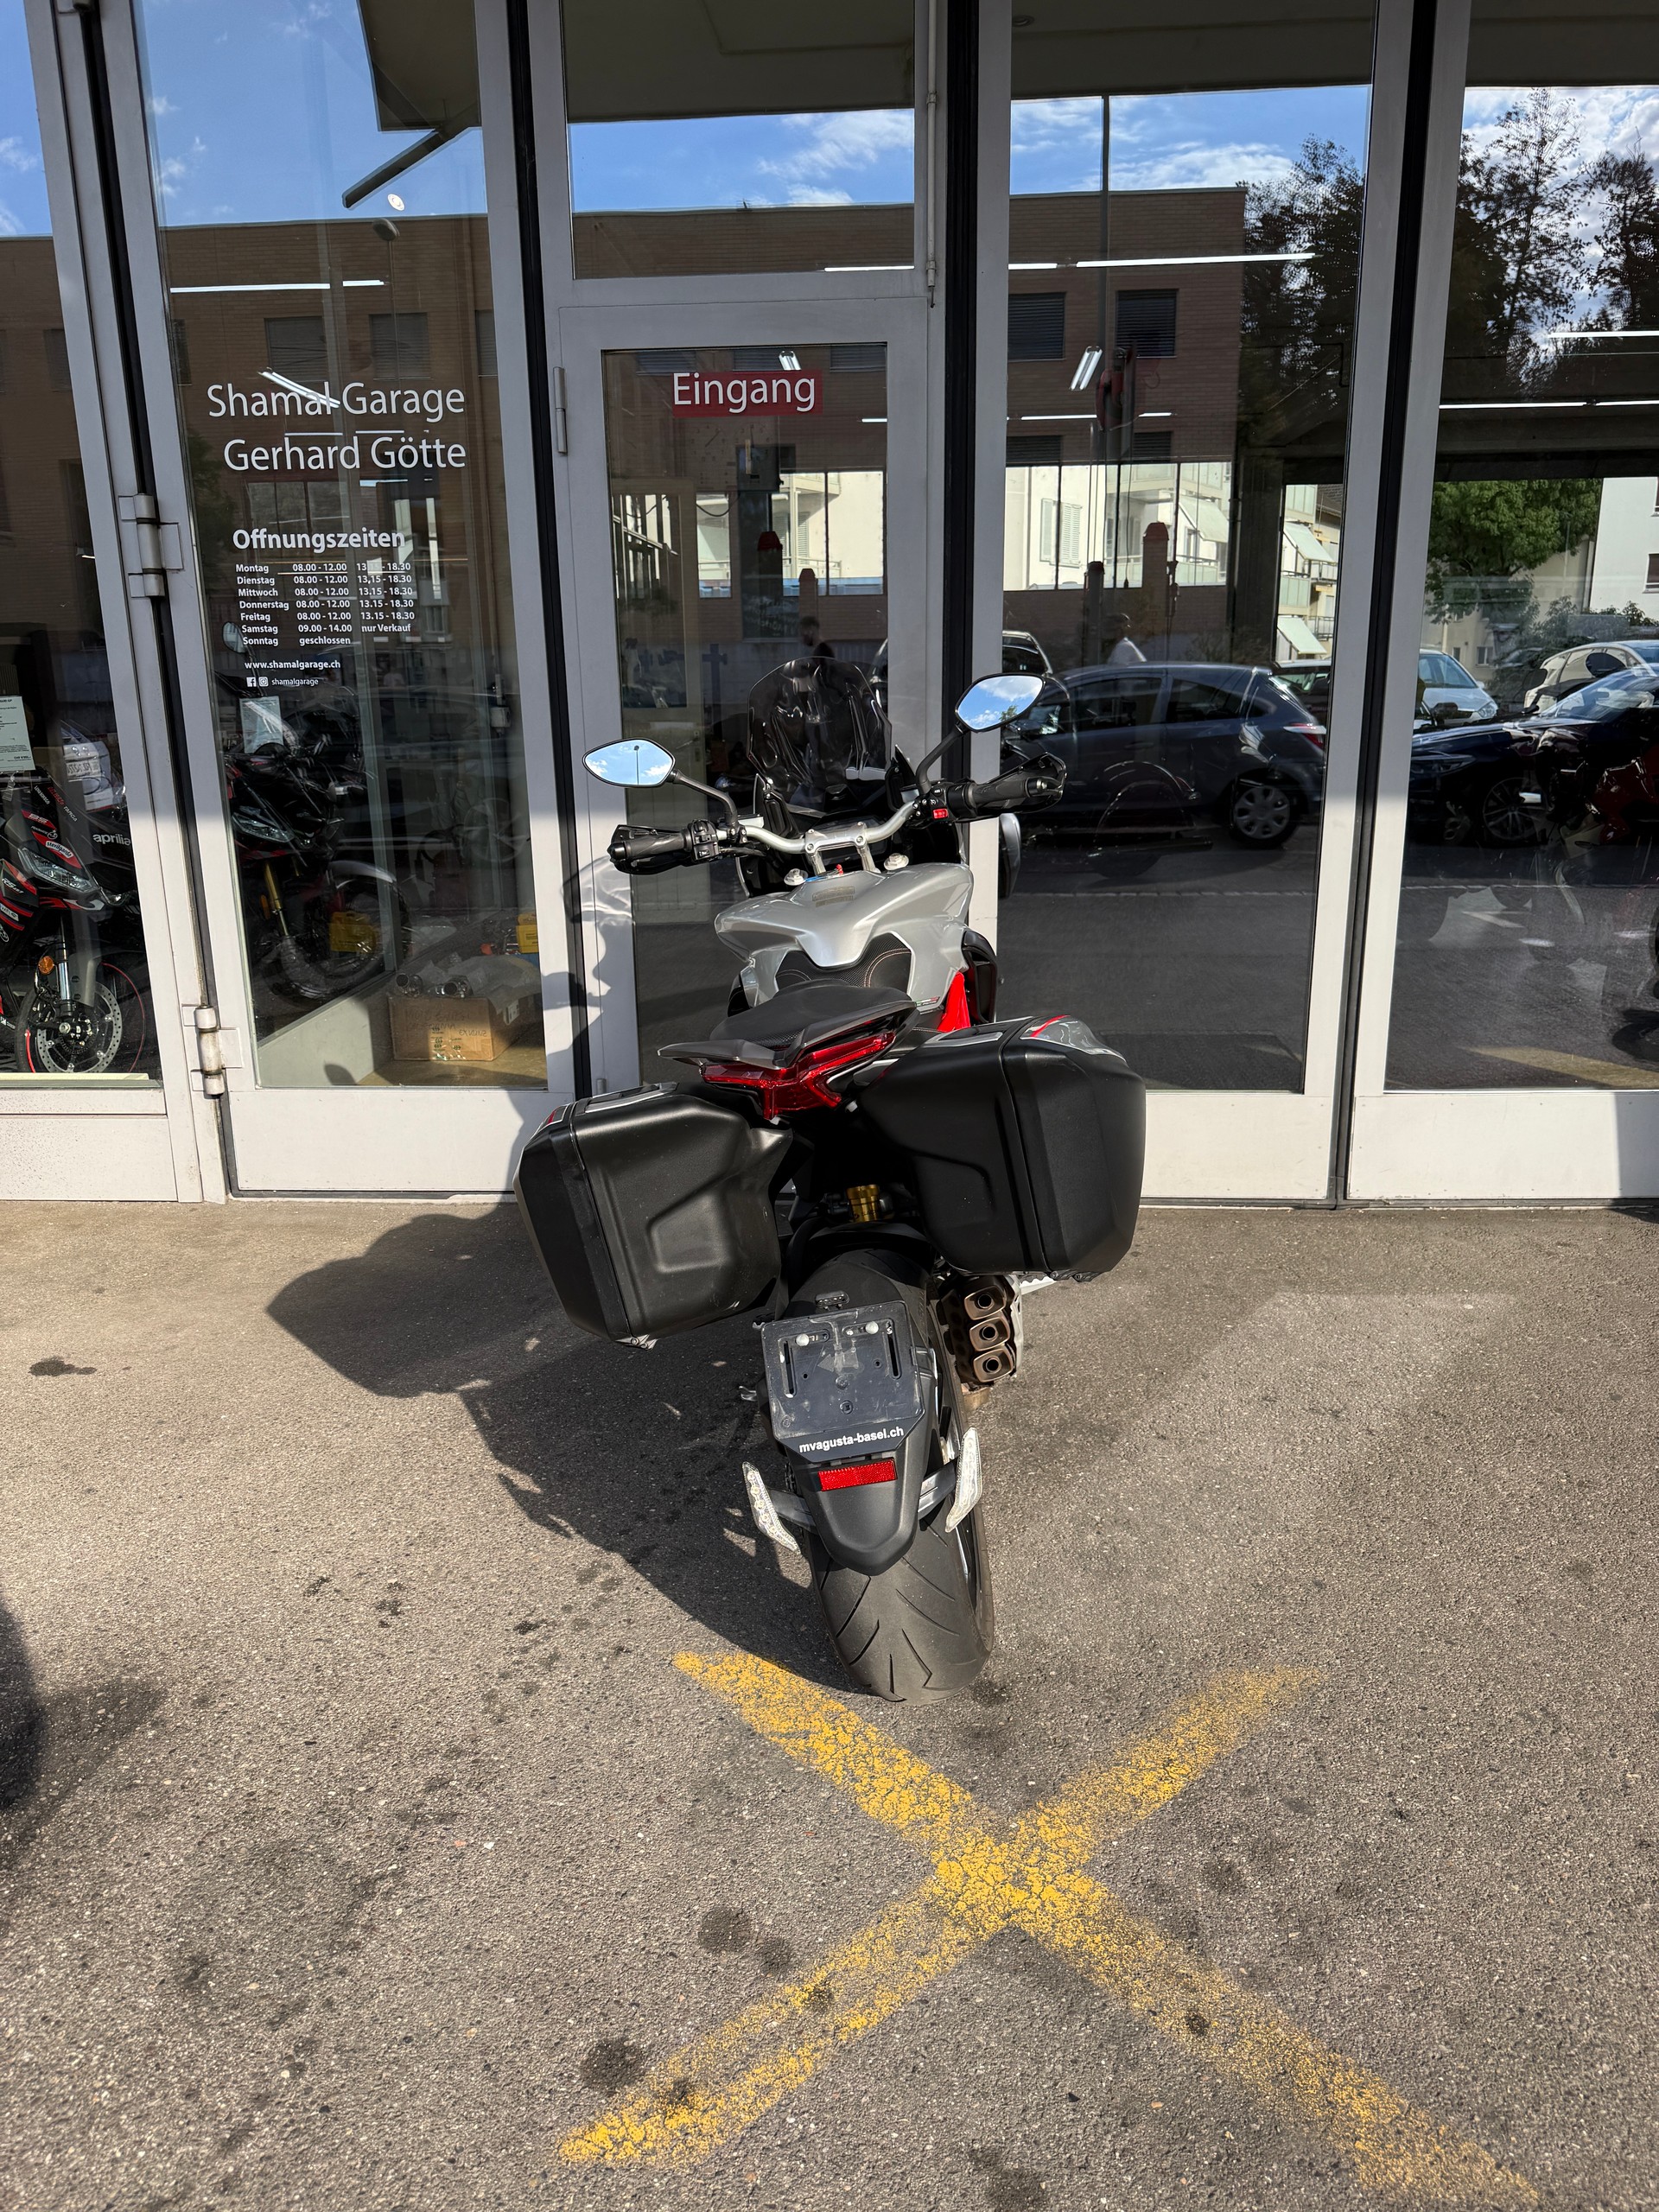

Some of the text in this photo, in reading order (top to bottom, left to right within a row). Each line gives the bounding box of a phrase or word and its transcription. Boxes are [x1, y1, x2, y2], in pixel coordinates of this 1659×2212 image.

[674, 372, 815, 413] Eingang
[207, 381, 465, 423] Shamal Garage
[224, 435, 467, 471] Gerhard Götte
[236, 563, 270, 573] Montag
[237, 576, 276, 585] Dienstag
[388, 575, 412, 583] 18.30
[238, 588, 278, 596] Mittwoch
[295, 588, 319, 596] 08.00
[389, 587, 413, 595] 18.30
[239, 601, 289, 611] Donnerstag
[296, 600, 320, 608] 08.00
[390, 599, 414, 607] 18.30
[241, 613, 270, 622] Freitag
[297, 612, 321, 620] 08.00
[241, 625, 278, 634] Samstag
[377, 624, 411, 632] Verkauf
[242, 636, 351, 646] Sonntag geschlossen
[245, 660, 341, 670] www.shamalgarage.ch
[271, 678, 319, 687] shamalgarage
[92, 833, 131, 846] aprilia
[798, 1427, 905, 1452] mvagusta-basel.ch
